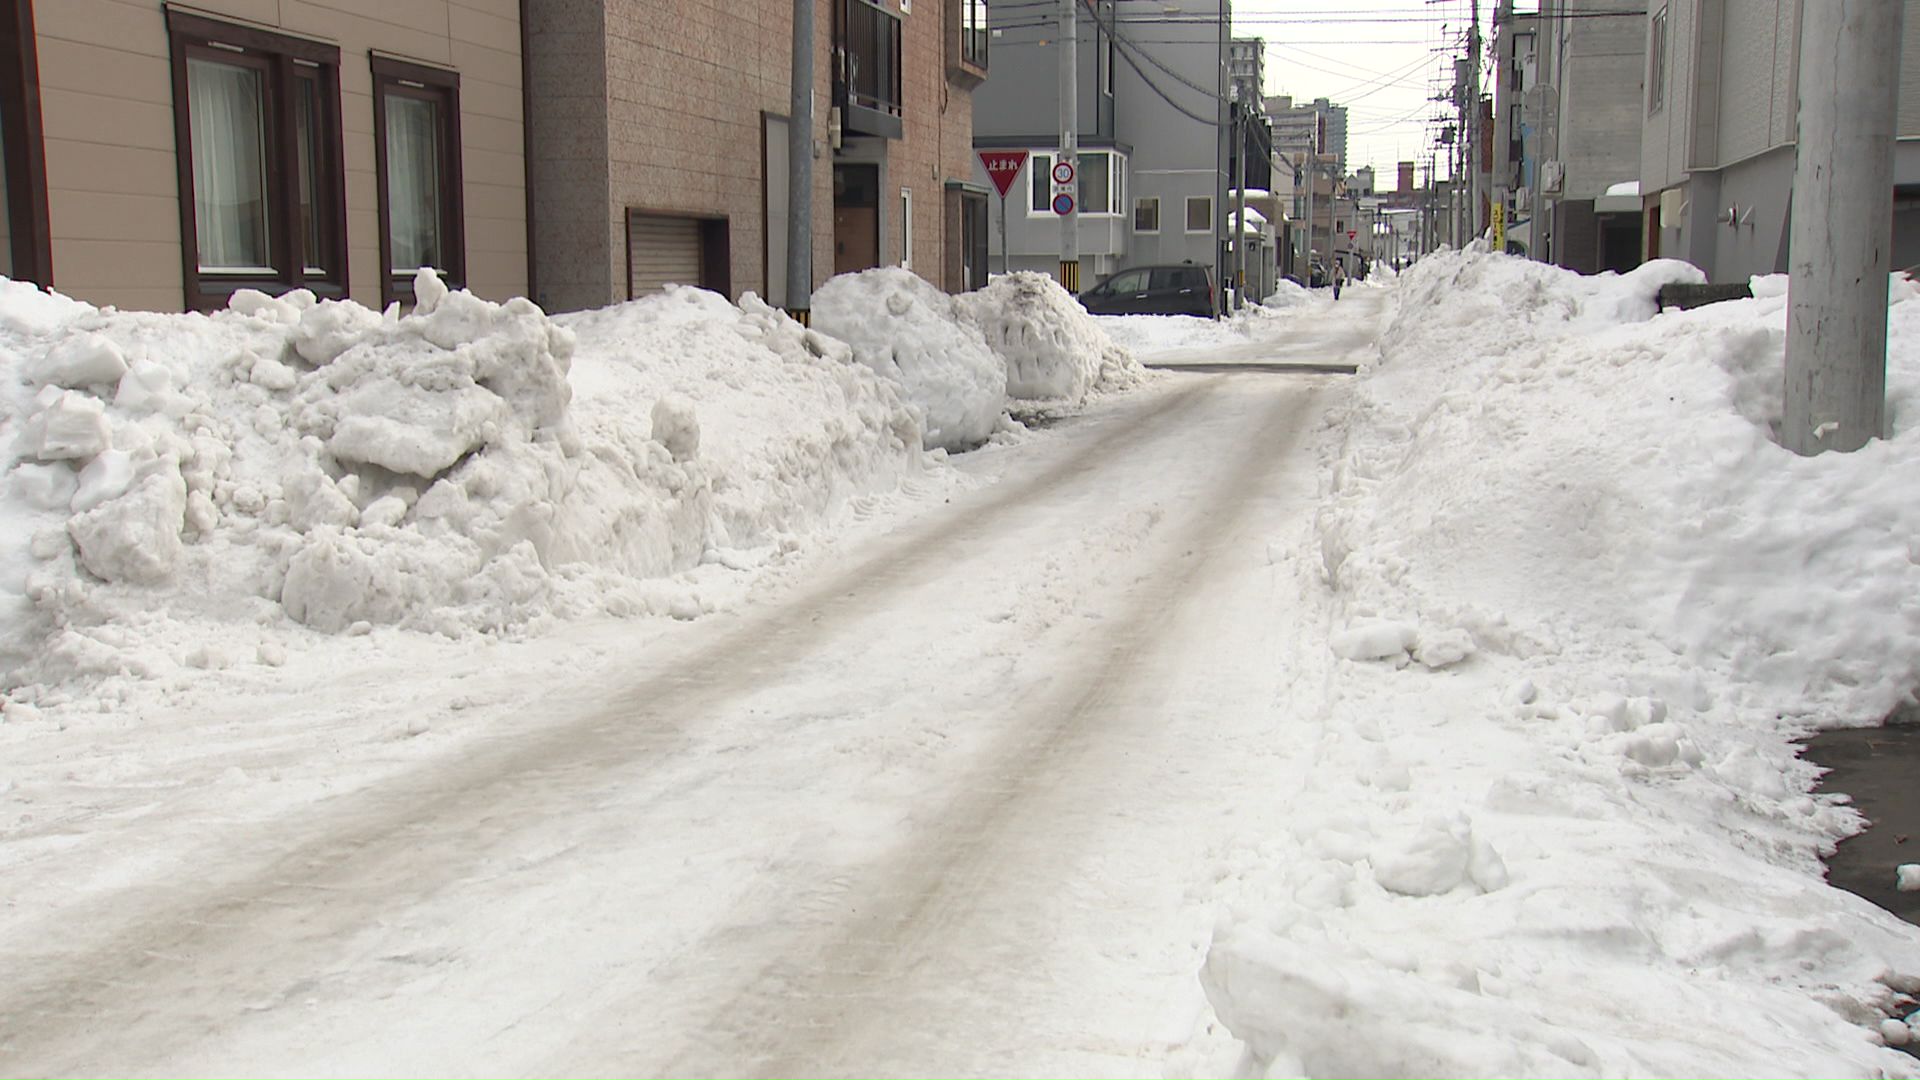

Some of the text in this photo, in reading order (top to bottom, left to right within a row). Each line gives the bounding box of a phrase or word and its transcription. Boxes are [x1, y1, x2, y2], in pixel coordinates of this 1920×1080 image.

[988, 159, 1018, 171] 止まれ
[1057, 168, 1069, 179] 30
